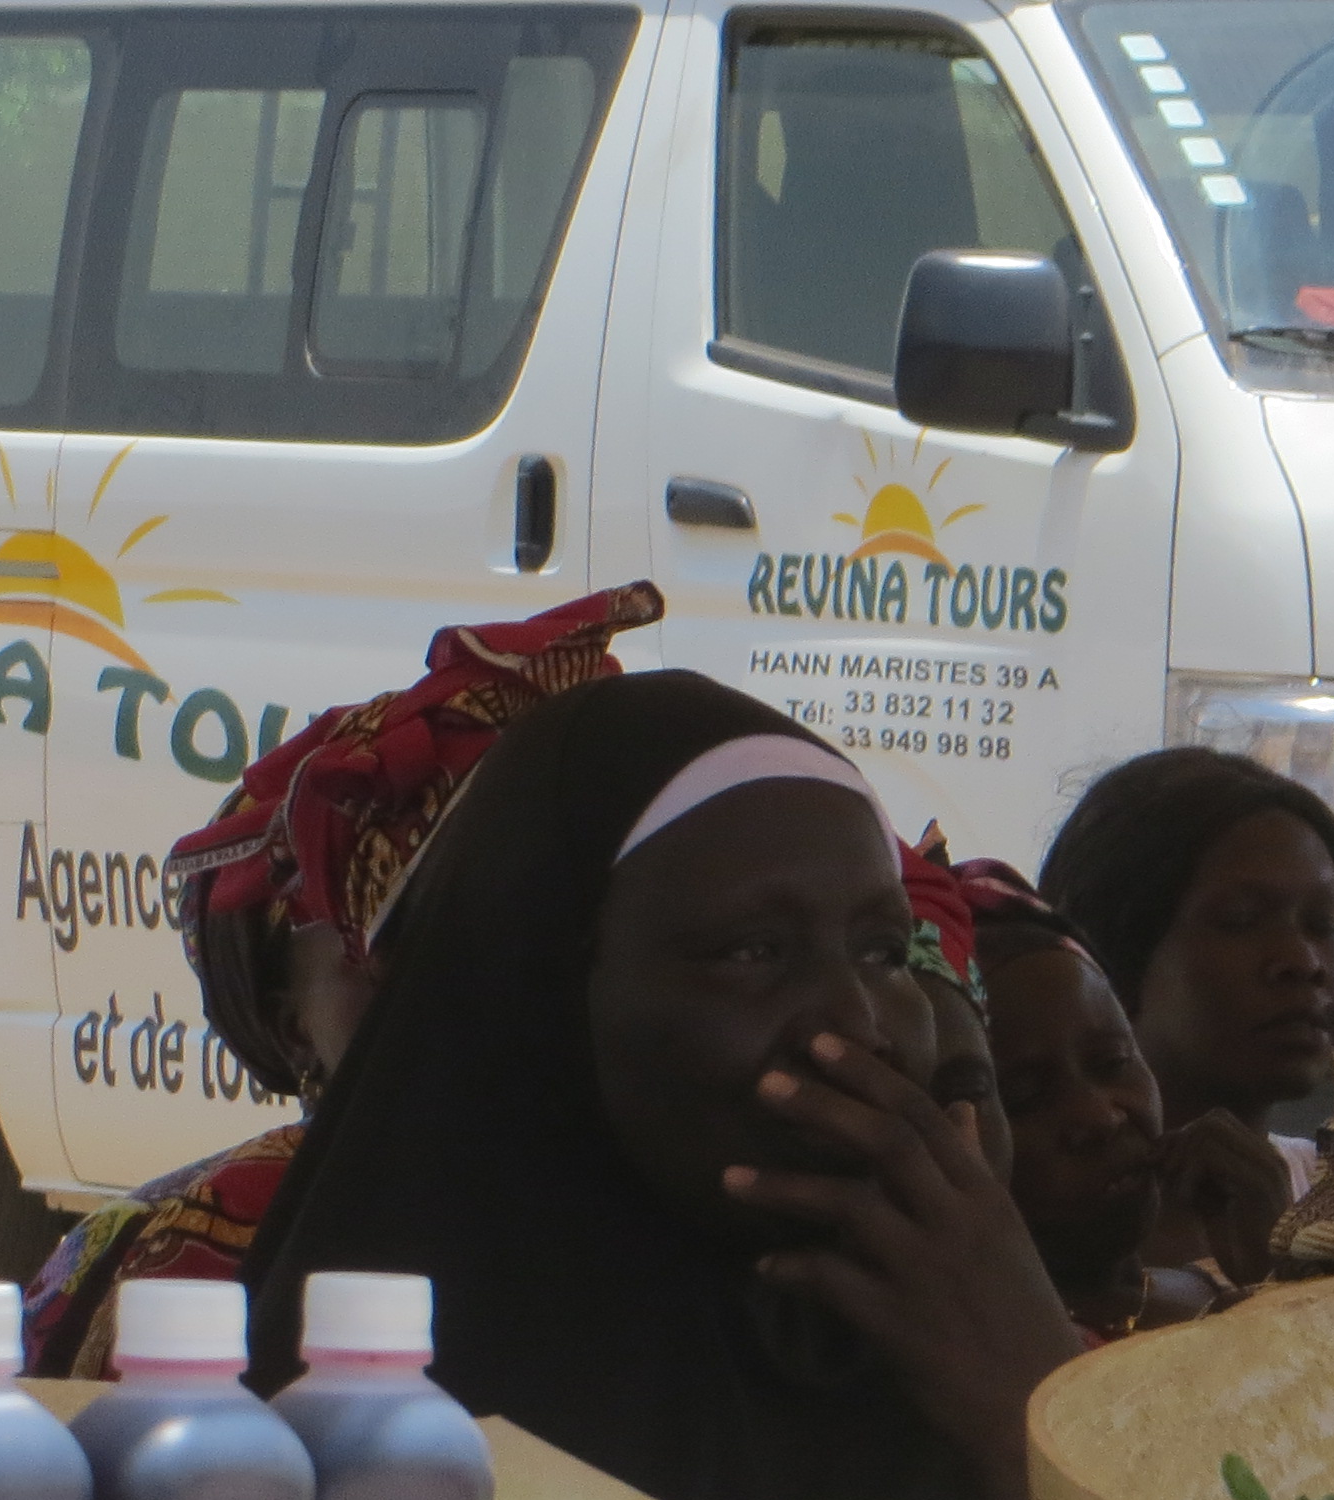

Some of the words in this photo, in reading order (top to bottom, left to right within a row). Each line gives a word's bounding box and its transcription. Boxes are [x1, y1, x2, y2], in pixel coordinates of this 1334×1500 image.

[748, 551, 908, 624] REVINA
[923, 562, 1069, 634] TOURS
[750, 649, 831, 678] HANN
[839, 654, 987, 687] MARISTES
[996, 664, 1028, 687] 39
[1038, 667, 1060, 691] A
[787, 698, 834, 726] Tél:
[844, 690, 876, 715] 33
[884, 693, 932, 719] 832
[943, 698, 970, 721] 11
[981, 699, 1015, 726] 32
[841, 725, 873, 749] 33
[880, 730, 928, 754] 949
[937, 734, 969, 757] 98
[979, 737, 1012, 761] 98
[17, 818, 184, 953] Agence
[73, 989, 124, 1088] et
[129, 990, 188, 1094] de
